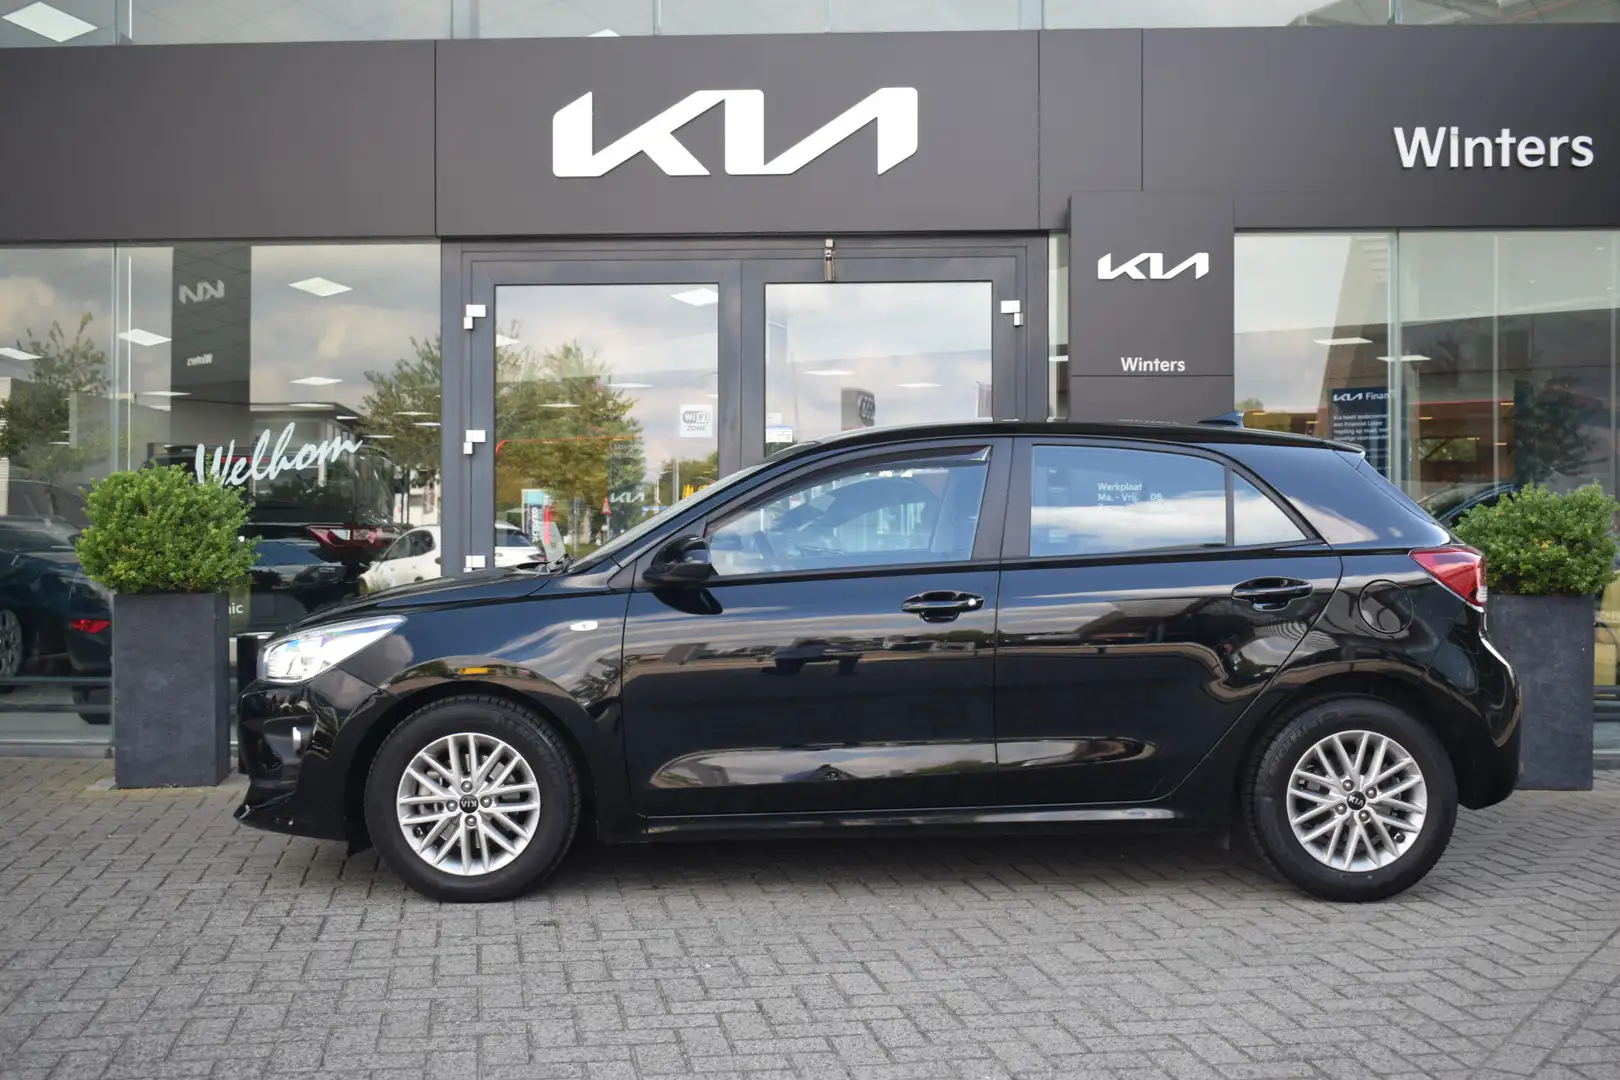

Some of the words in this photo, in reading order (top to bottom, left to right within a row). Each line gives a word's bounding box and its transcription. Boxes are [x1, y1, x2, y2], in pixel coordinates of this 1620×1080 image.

[552, 87, 919, 178] KIA
[1394, 126, 1594, 168] Winters
[1098, 252, 1209, 280] KIA
[1121, 357, 1186, 372] Winters
[1333, 392, 1363, 402] KIA
